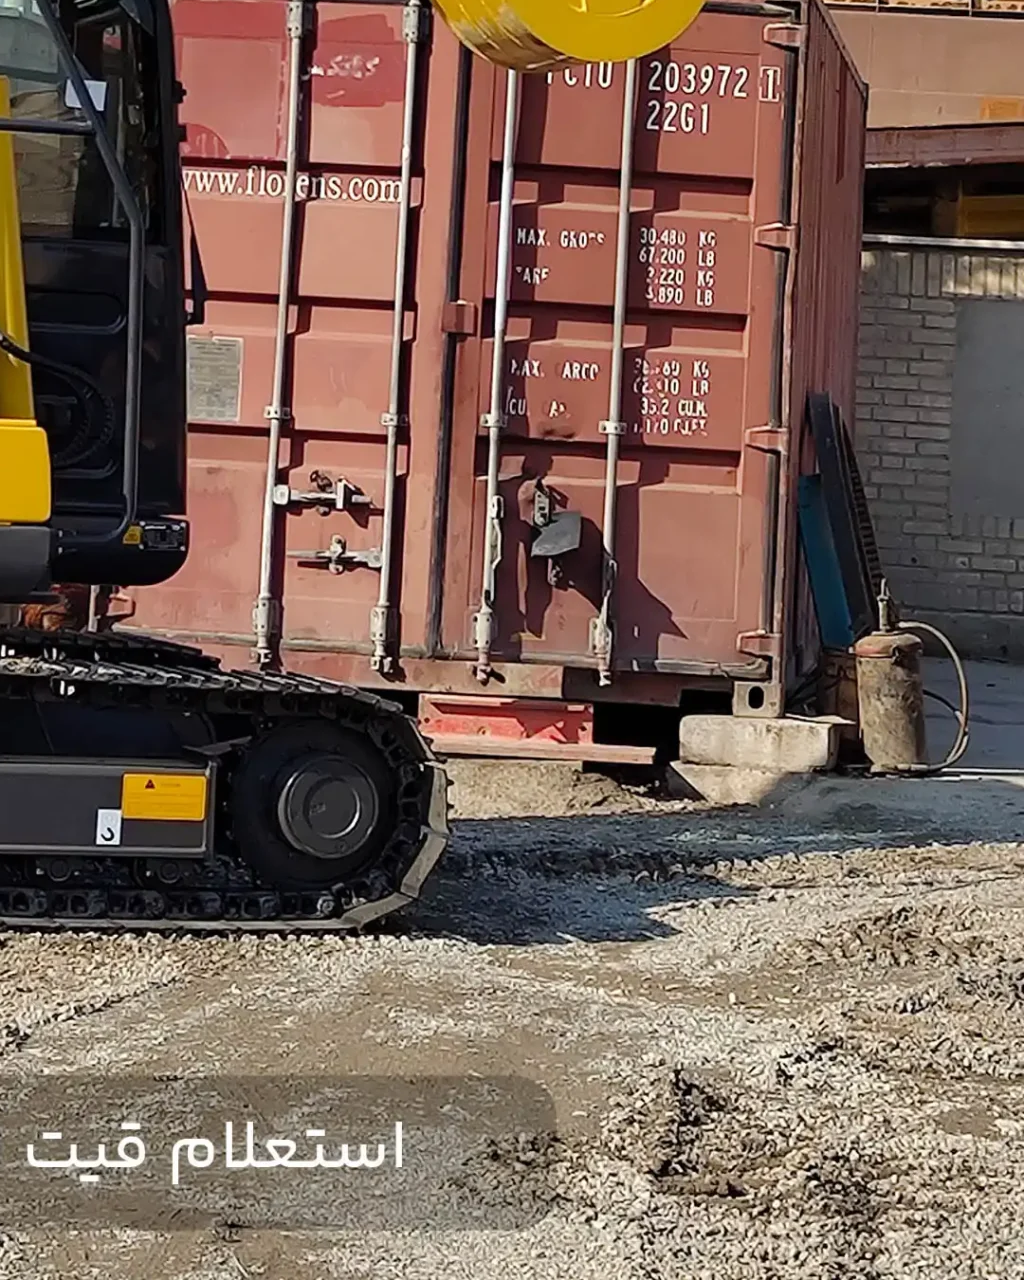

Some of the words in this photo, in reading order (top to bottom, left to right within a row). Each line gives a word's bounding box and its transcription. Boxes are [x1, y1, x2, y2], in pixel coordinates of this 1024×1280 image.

[647, 61, 749, 98] 203972
[762, 67, 777, 100] 1
[645, 100, 710, 134] 22G1
[517, 227, 551, 247] MAX.
[640, 227, 686, 246] 30.480
[639, 246, 686, 266] 67.200
[698, 249, 715, 267] LB
[696, 288, 713, 307] LB
